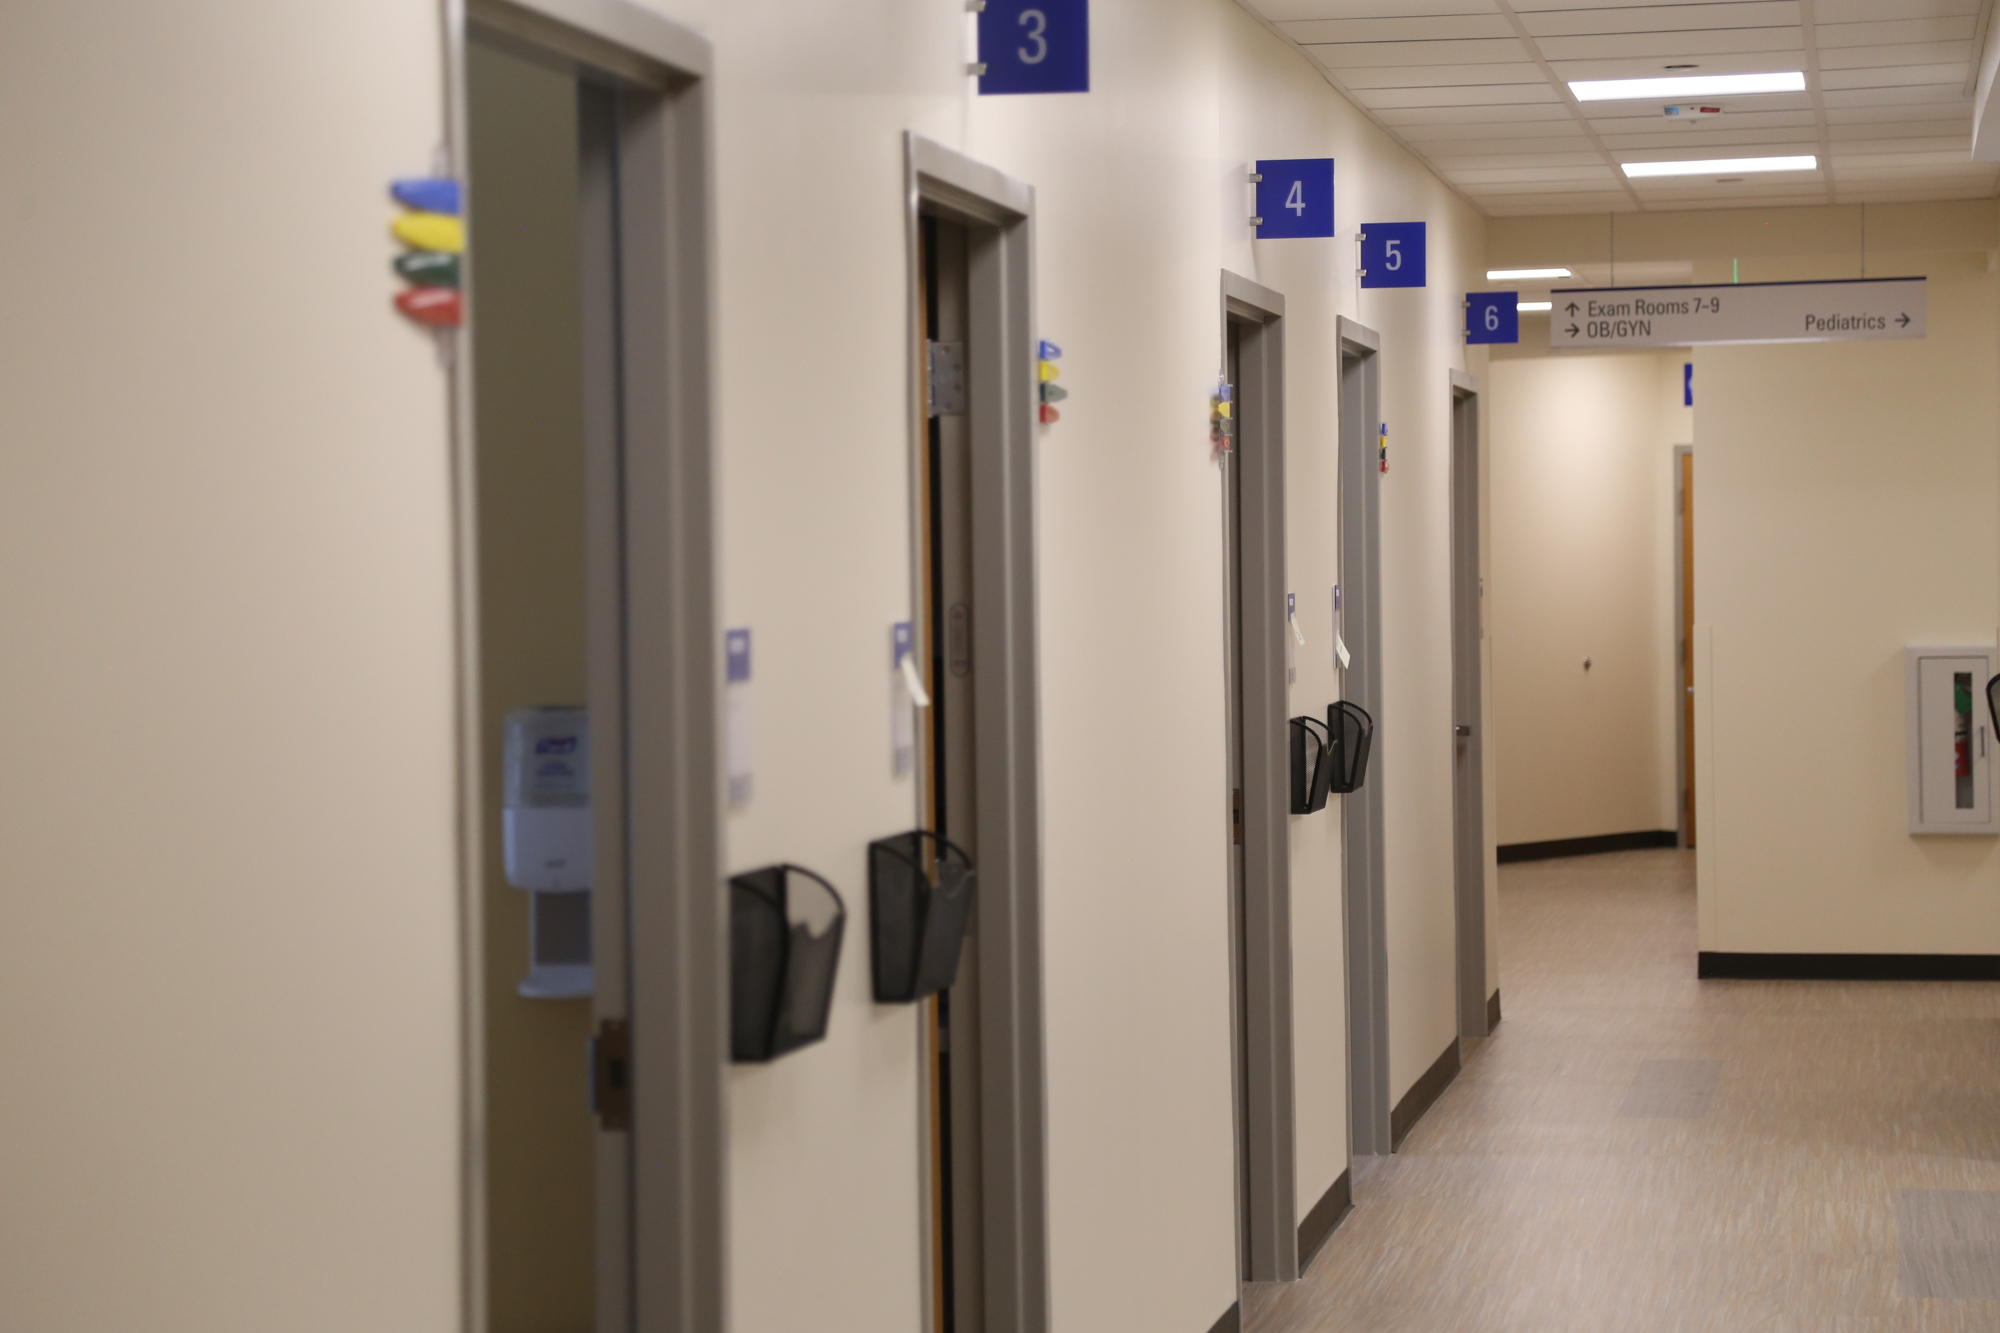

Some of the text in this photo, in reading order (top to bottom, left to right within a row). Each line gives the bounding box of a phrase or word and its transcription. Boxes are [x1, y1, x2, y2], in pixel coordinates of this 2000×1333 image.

[1017, 9, 1048, 64] 3
[1285, 180, 1305, 216] 4
[1385, 239, 1402, 271] 5
[1484, 305, 1499, 331] 6
[1588, 297, 1720, 317] Exam Rooms 7-9
[1587, 320, 1651, 339] OB/GYN
[1805, 313, 1886, 330] Pediatrics
